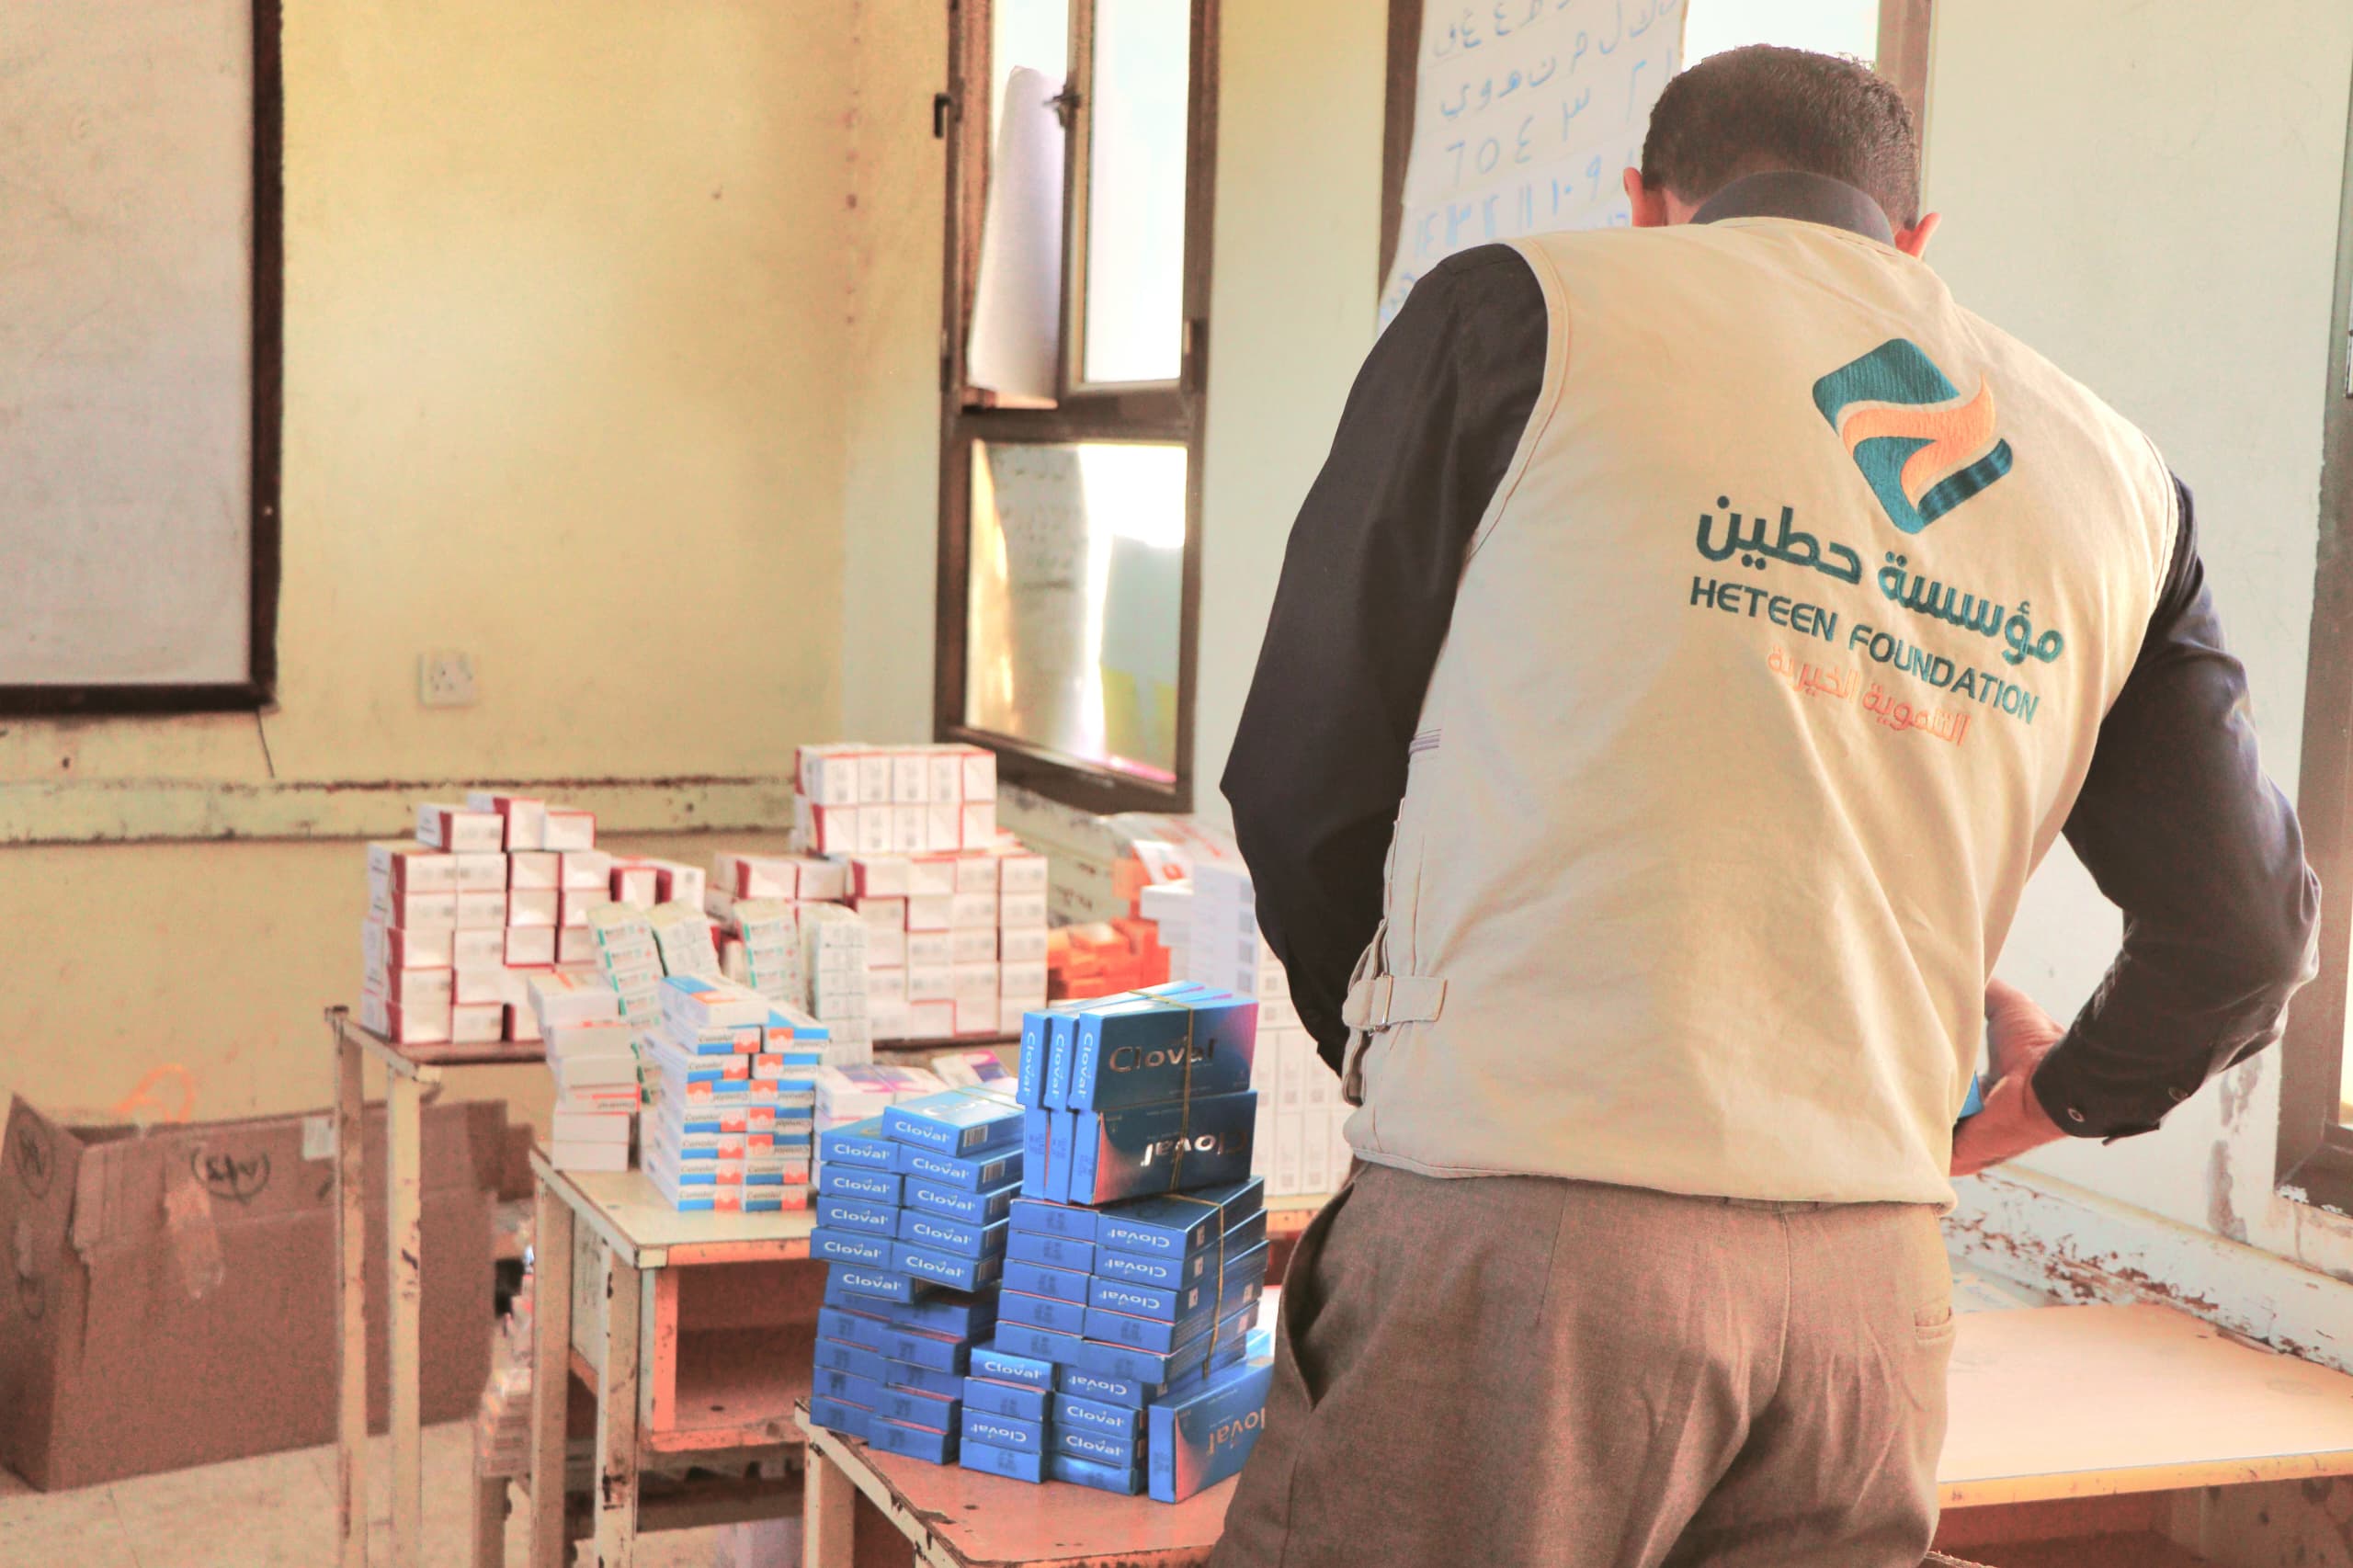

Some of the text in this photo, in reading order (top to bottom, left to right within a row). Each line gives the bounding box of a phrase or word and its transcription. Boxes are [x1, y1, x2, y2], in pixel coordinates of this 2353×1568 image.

[1697, 495, 2064, 666] مؤسسة حطين
[1689, 575, 2040, 725] HETEEN FOUNDATION
[1768, 644, 1972, 747] التنموية الخيرية
[1023, 1031, 1037, 1094] Cloval
[1051, 1033, 1065, 1096] Cloval
[1078, 1031, 1094, 1096] Cloval
[1108, 1037, 1218, 1074] Cloval
[894, 1119, 949, 1143] Cloval
[833, 1142, 888, 1160] Cloval
[1140, 1125, 1249, 1167] Cloval
[912, 1156, 968, 1179] Cloval
[833, 1176, 888, 1194] Cloval
[917, 1188, 973, 1211] Cloval
[830, 1208, 886, 1225] Cloval
[913, 1222, 970, 1244] Cloval
[1109, 1228, 1171, 1248] Cloval
[824, 1240, 880, 1259] Cloval
[905, 1256, 962, 1278] Cloval
[1108, 1257, 1167, 1278] Cloval
[842, 1272, 898, 1290] Cloval
[1102, 1290, 1161, 1310] Cloval
[984, 1360, 1040, 1379] Cloval
[1071, 1374, 1128, 1396] Cloval
[1066, 1404, 1122, 1427] Cloval
[972, 1423, 1028, 1443] Cloval
[1206, 1406, 1266, 1456] loval
[1065, 1435, 1121, 1457] Cloval
